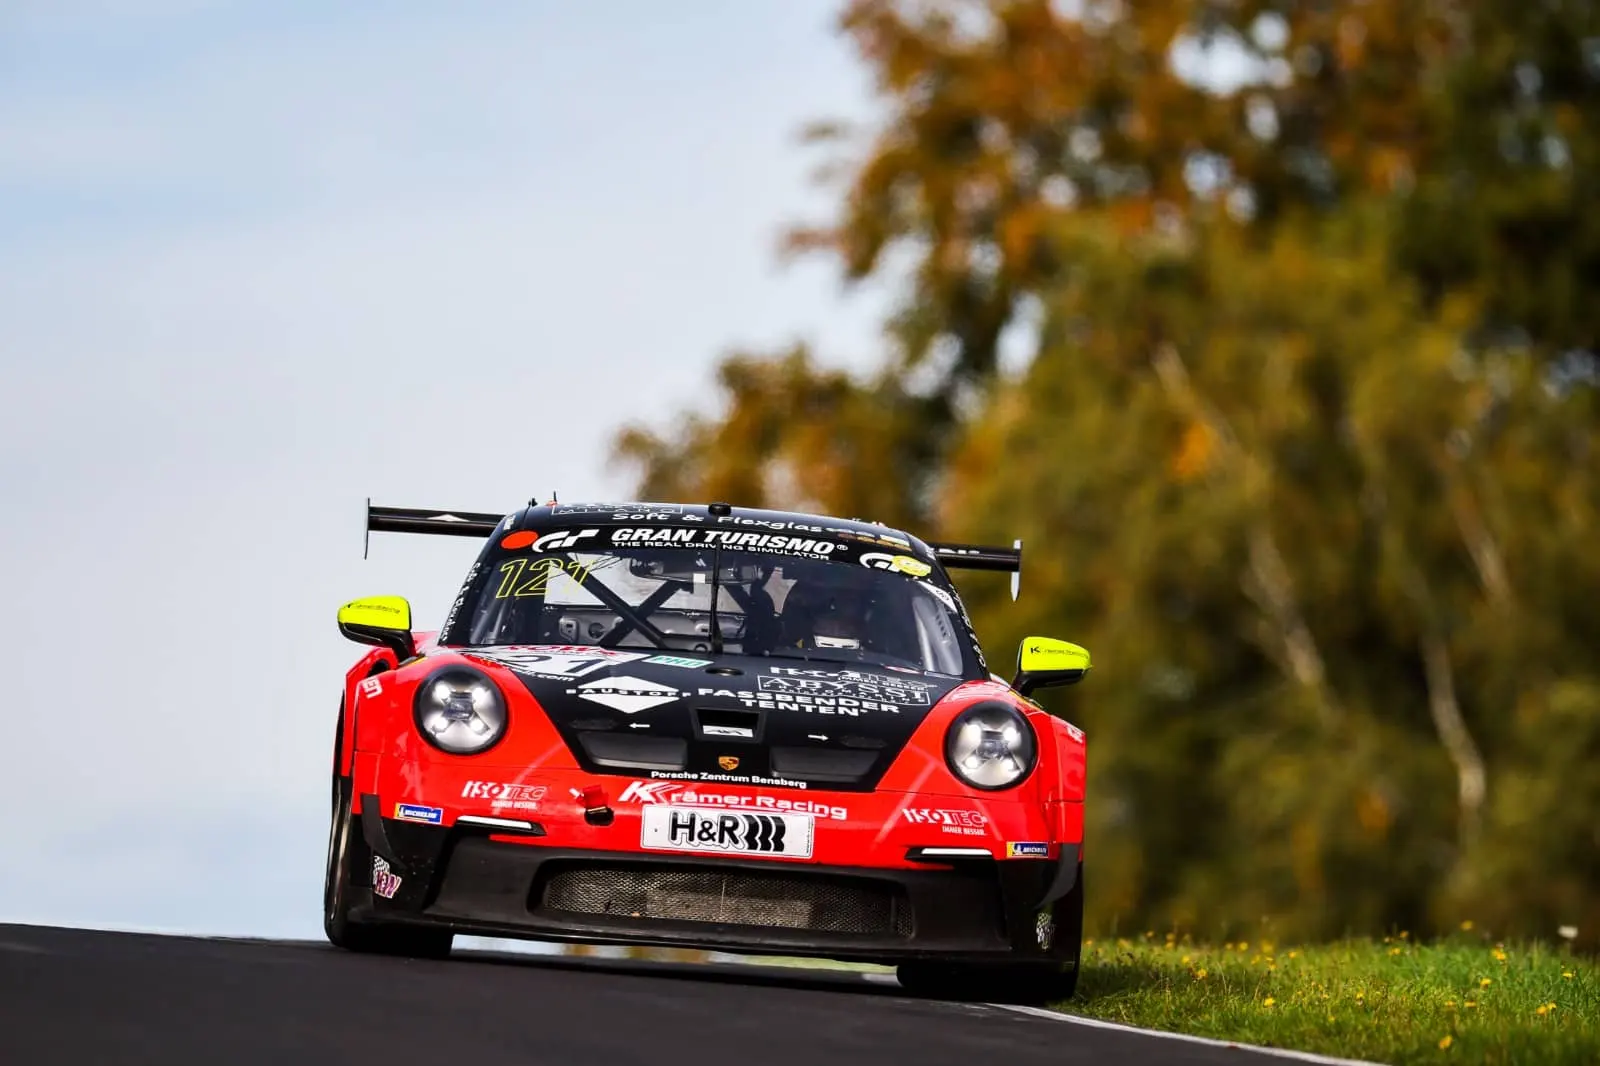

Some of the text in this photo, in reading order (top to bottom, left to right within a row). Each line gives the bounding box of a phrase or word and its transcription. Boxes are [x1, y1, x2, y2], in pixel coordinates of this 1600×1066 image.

[612, 512, 670, 520] Soft
[682, 514, 704, 522] &
[611, 528, 697, 542] GRAN
[685, 542, 744, 551] DRIVNG
[746, 546, 830, 560] SIMULATOR
[697, 687, 900, 714] FASSBENDER
[650, 770, 808, 790] Porsche Zentrum Bensberg
[618, 780, 848, 820] Krämer Racing
[669, 811, 741, 846] H&R
